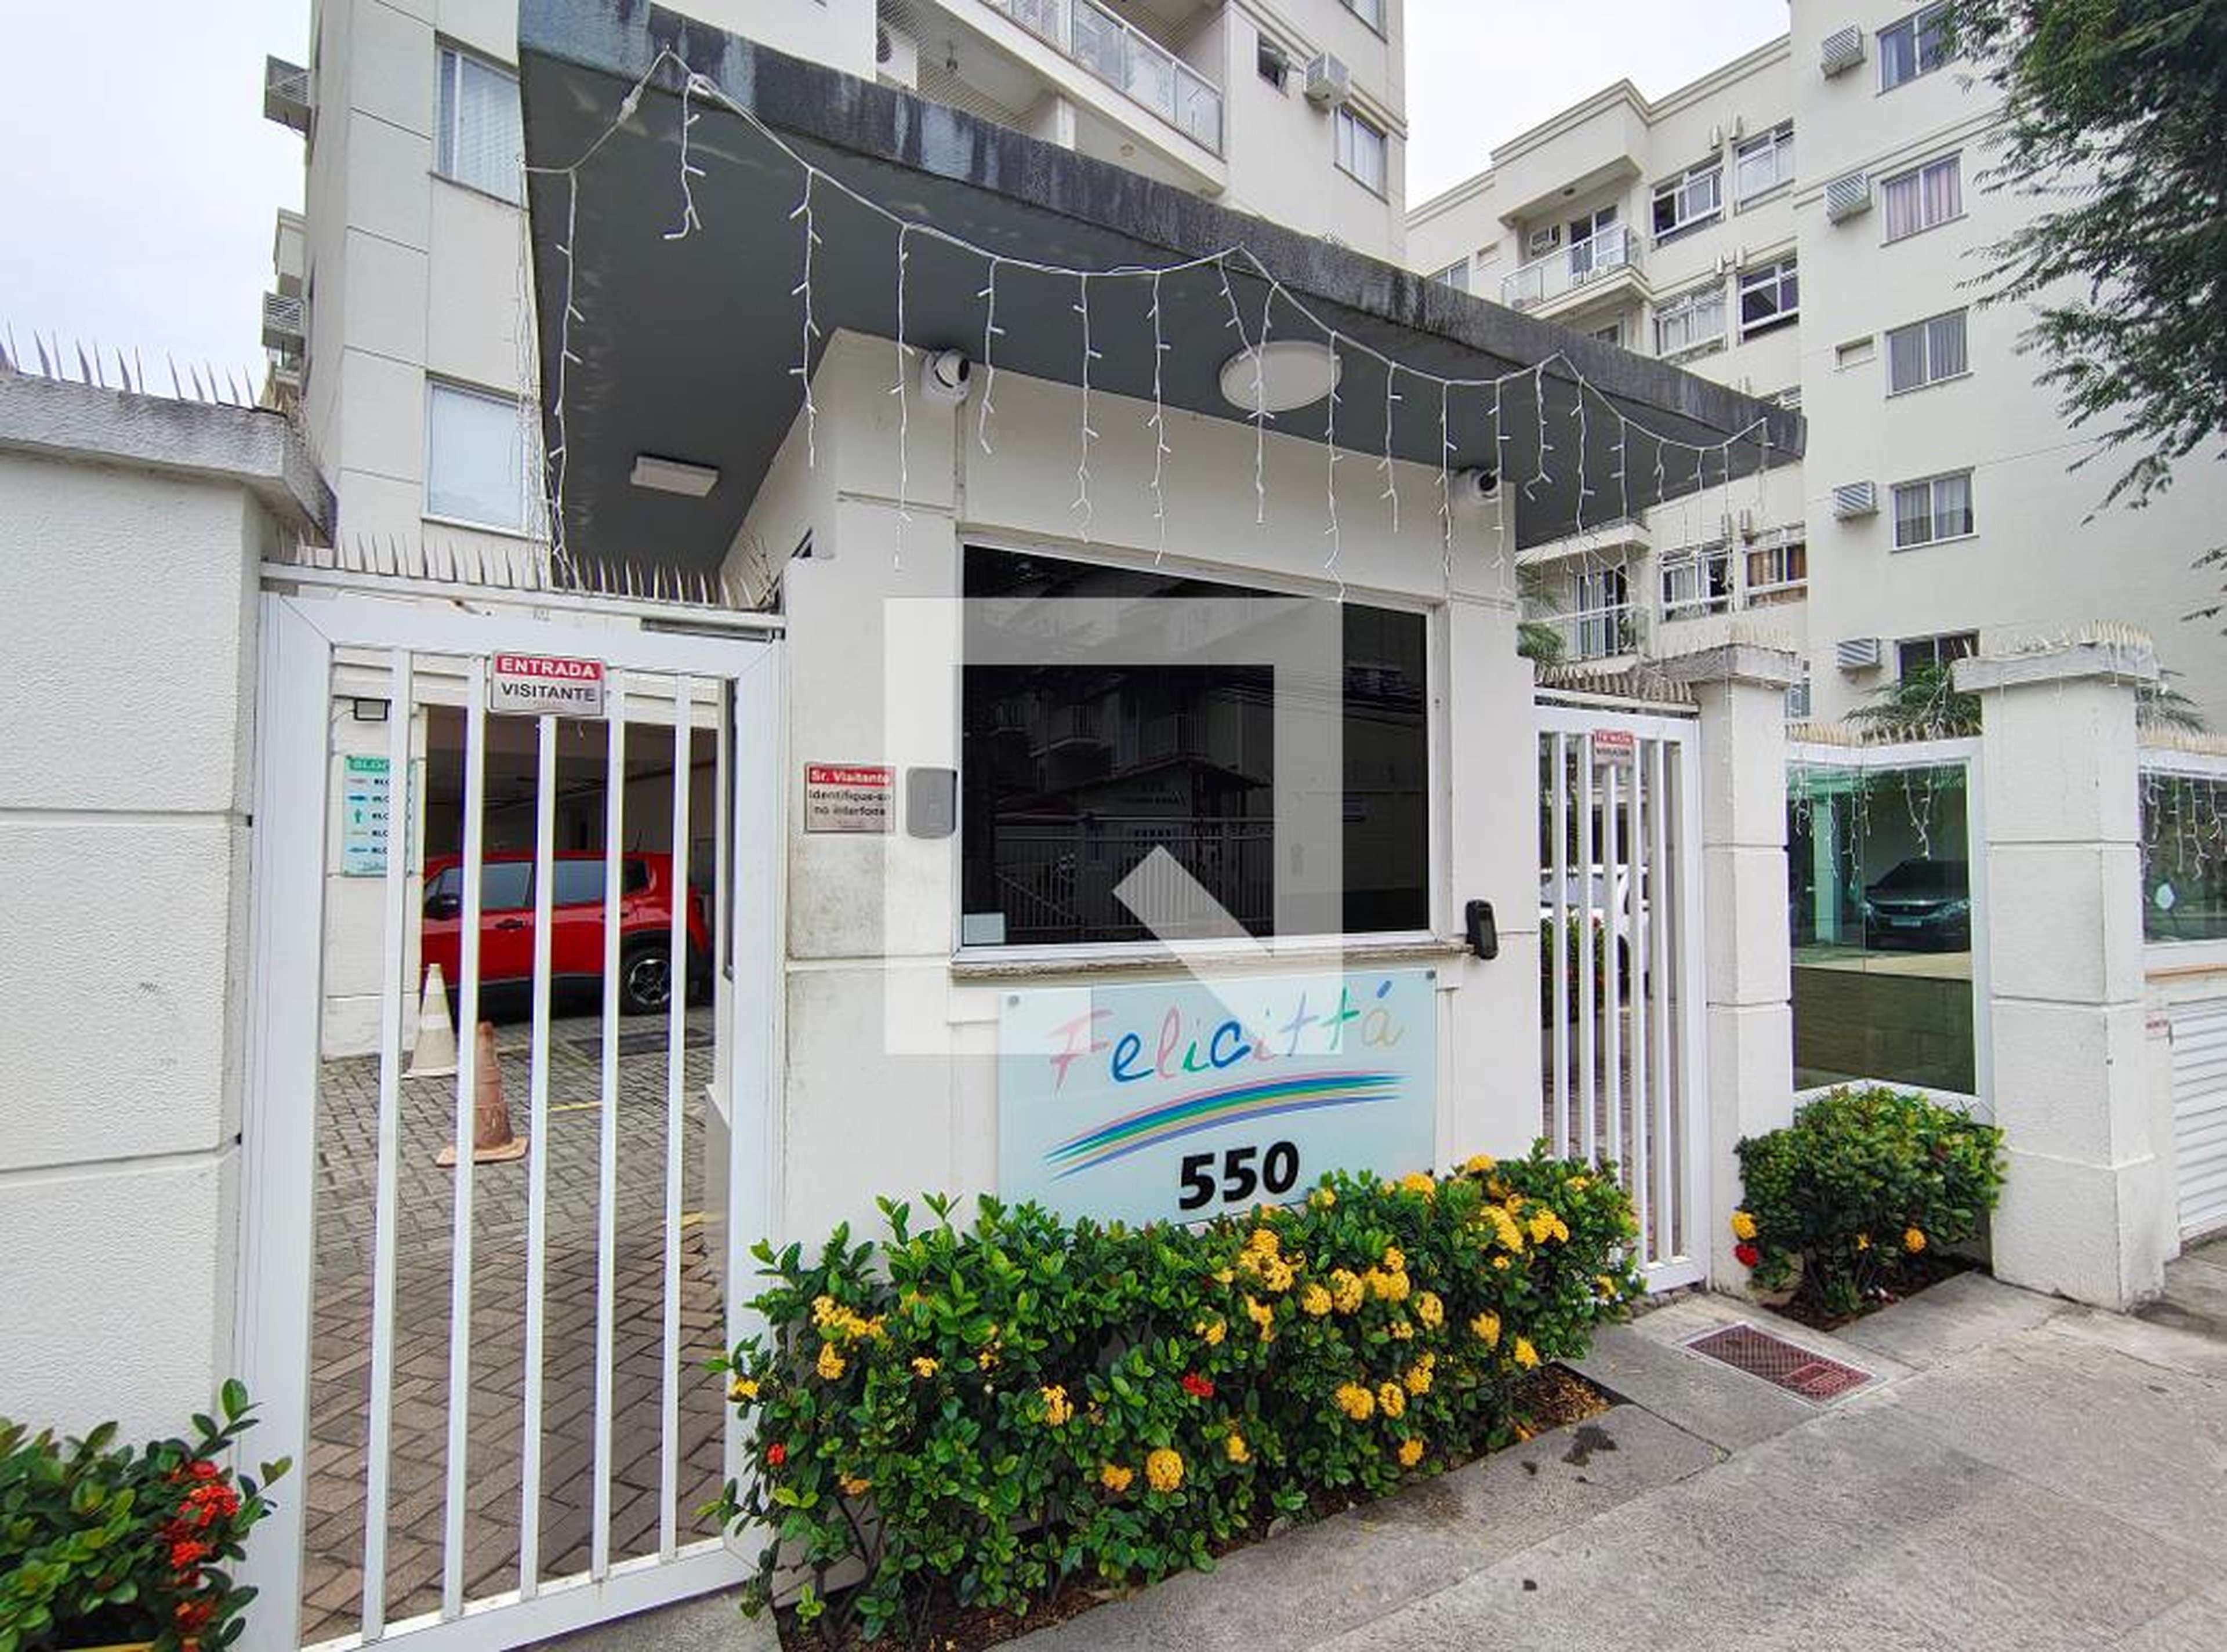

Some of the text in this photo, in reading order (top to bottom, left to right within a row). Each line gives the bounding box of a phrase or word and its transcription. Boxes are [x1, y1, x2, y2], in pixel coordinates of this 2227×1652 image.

[501, 658, 595, 678] ENTRADA
[502, 682, 596, 702] VISITANTE
[1178, 1141, 1299, 1210] 550
